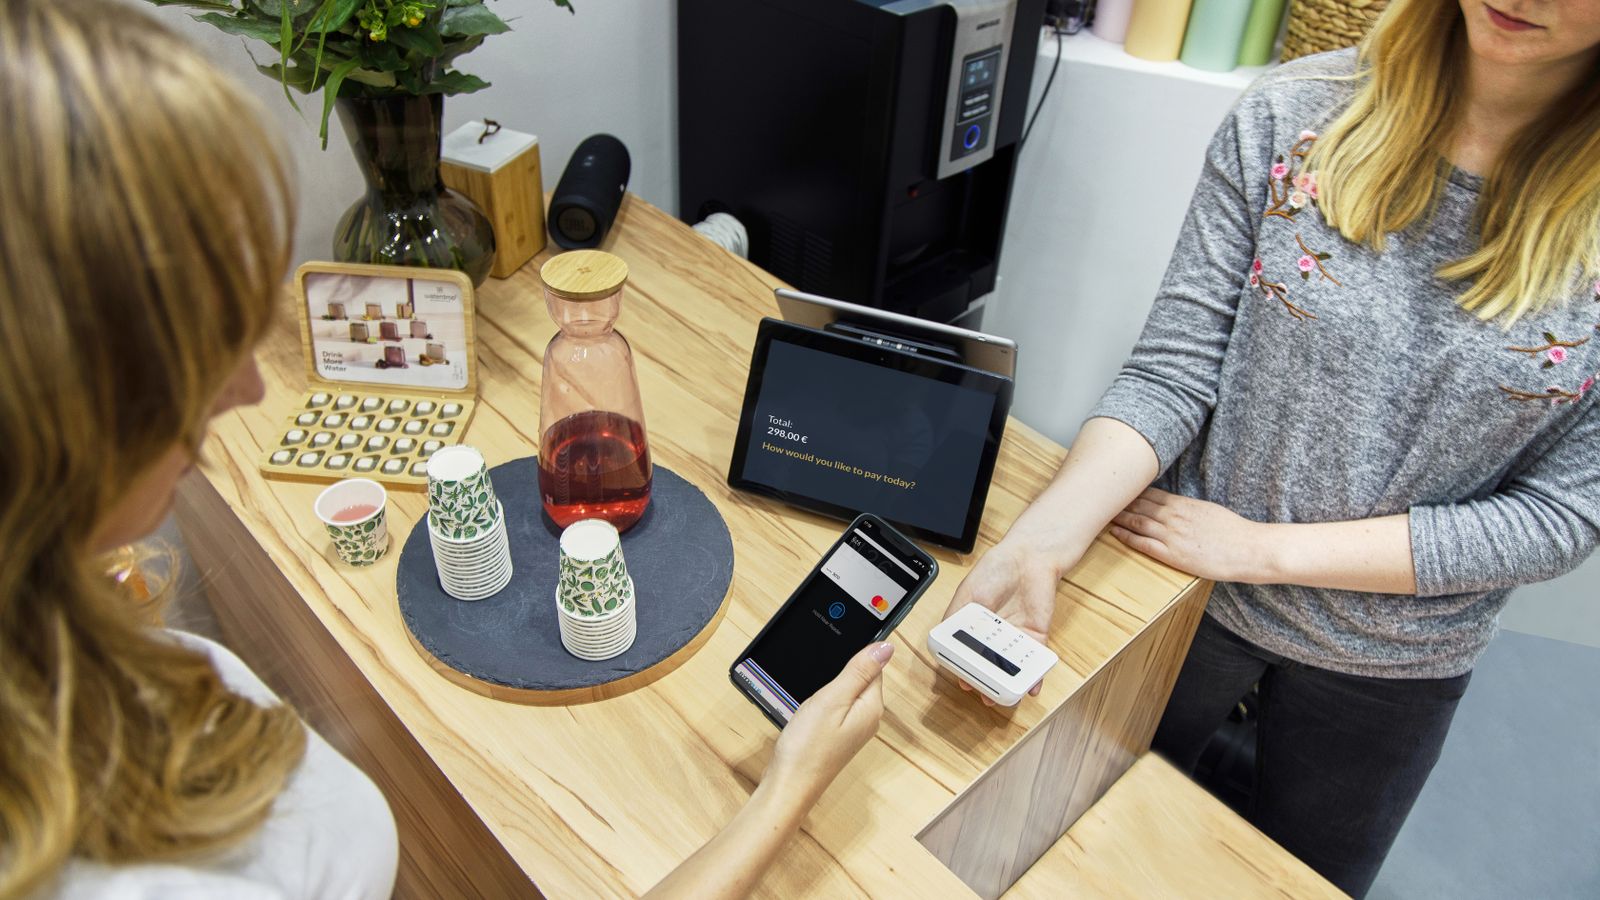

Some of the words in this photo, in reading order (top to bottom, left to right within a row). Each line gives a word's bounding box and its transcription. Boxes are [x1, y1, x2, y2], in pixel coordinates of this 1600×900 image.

[324, 364, 347, 372] Water
[768, 414, 793, 428] Total:
[767, 426, 800, 442] 298,00
[801, 435, 808, 444] €
[762, 442, 784, 454] How
[785, 449, 814, 462] would
[815, 458, 833, 469] you
[834, 461, 852, 473] like
[853, 466, 863, 476] to
[864, 469, 882, 482] pay
[883, 475, 916, 489] today?
